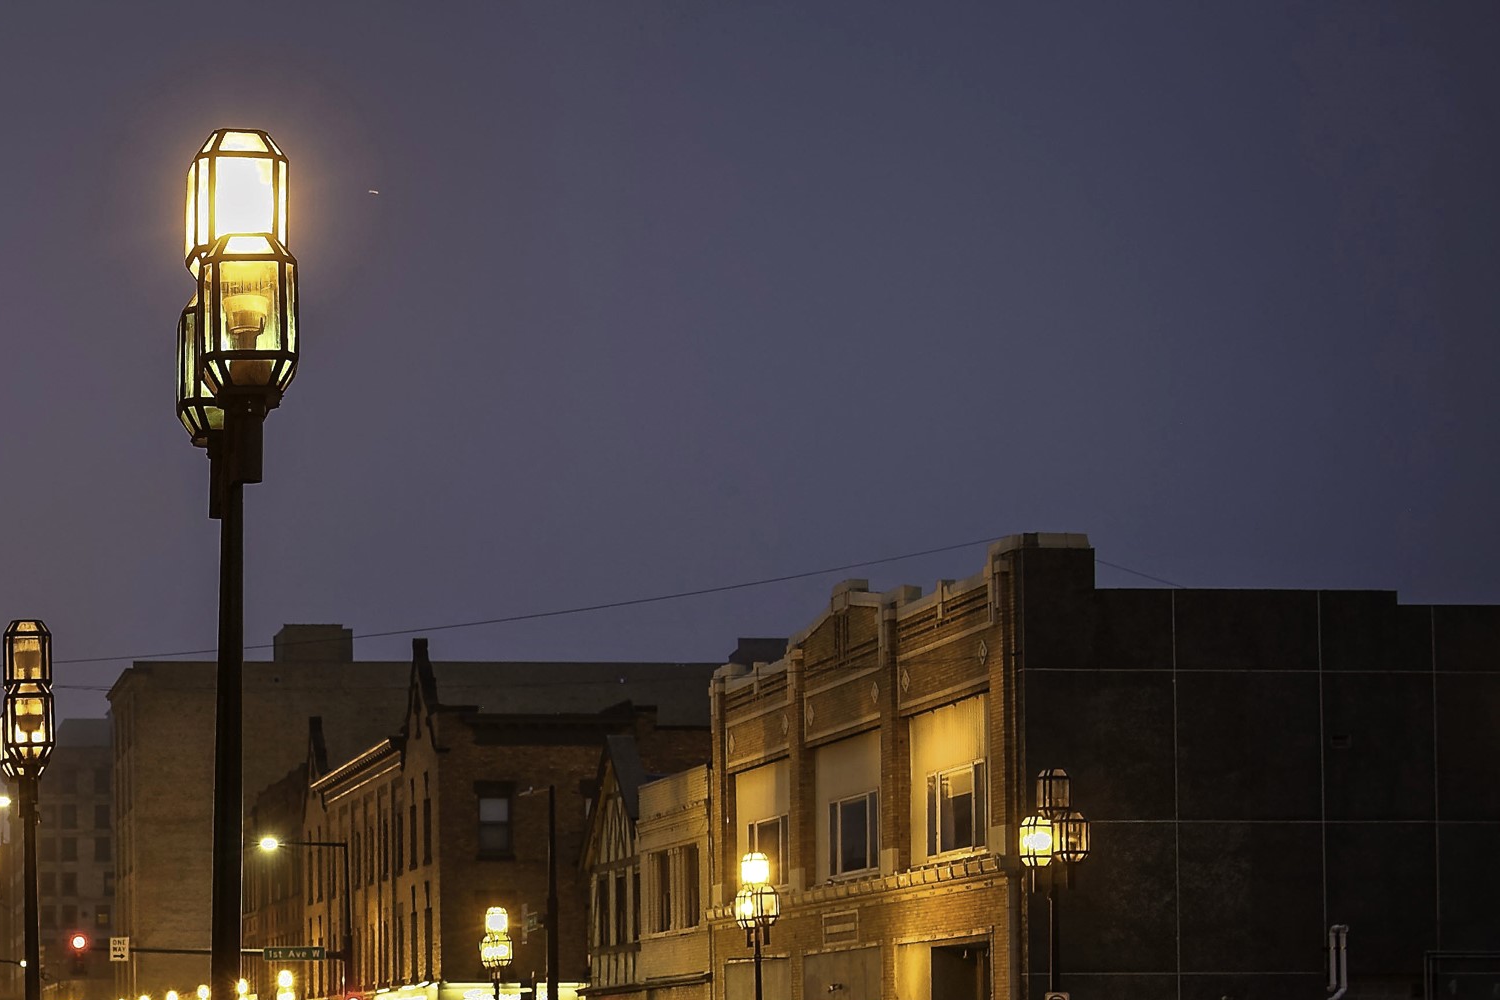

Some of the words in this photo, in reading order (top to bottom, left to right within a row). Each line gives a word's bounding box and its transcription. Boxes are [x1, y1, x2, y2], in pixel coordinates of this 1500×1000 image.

[112, 938, 126, 946] ONE
[268, 950, 283, 958] 1st
[288, 950, 307, 958] Ave
[311, 949, 320, 958] W
